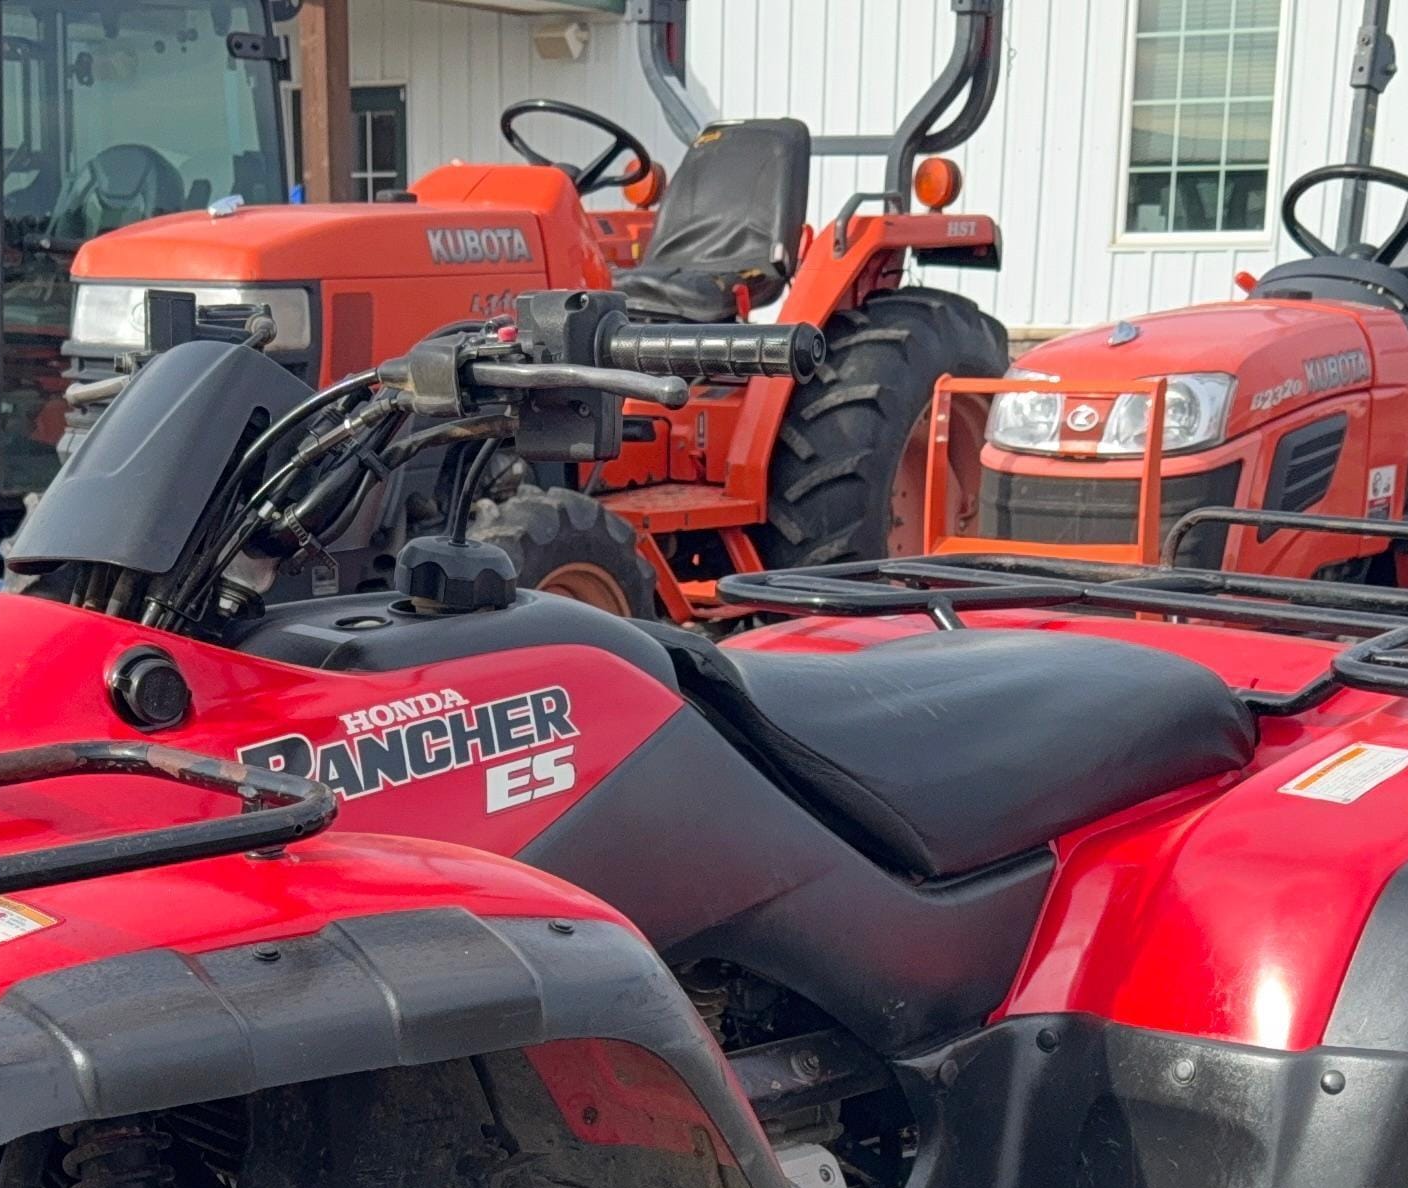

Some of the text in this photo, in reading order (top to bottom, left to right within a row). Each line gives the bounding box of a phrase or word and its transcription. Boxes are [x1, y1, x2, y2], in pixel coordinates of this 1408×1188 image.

[426, 228, 533, 264] KUBOTA
[1303, 349, 1370, 392] KUBOTA
[339, 688, 469, 735] HONDA
[237, 685, 581, 801] RANCHER
[486, 745, 576, 815] ES
